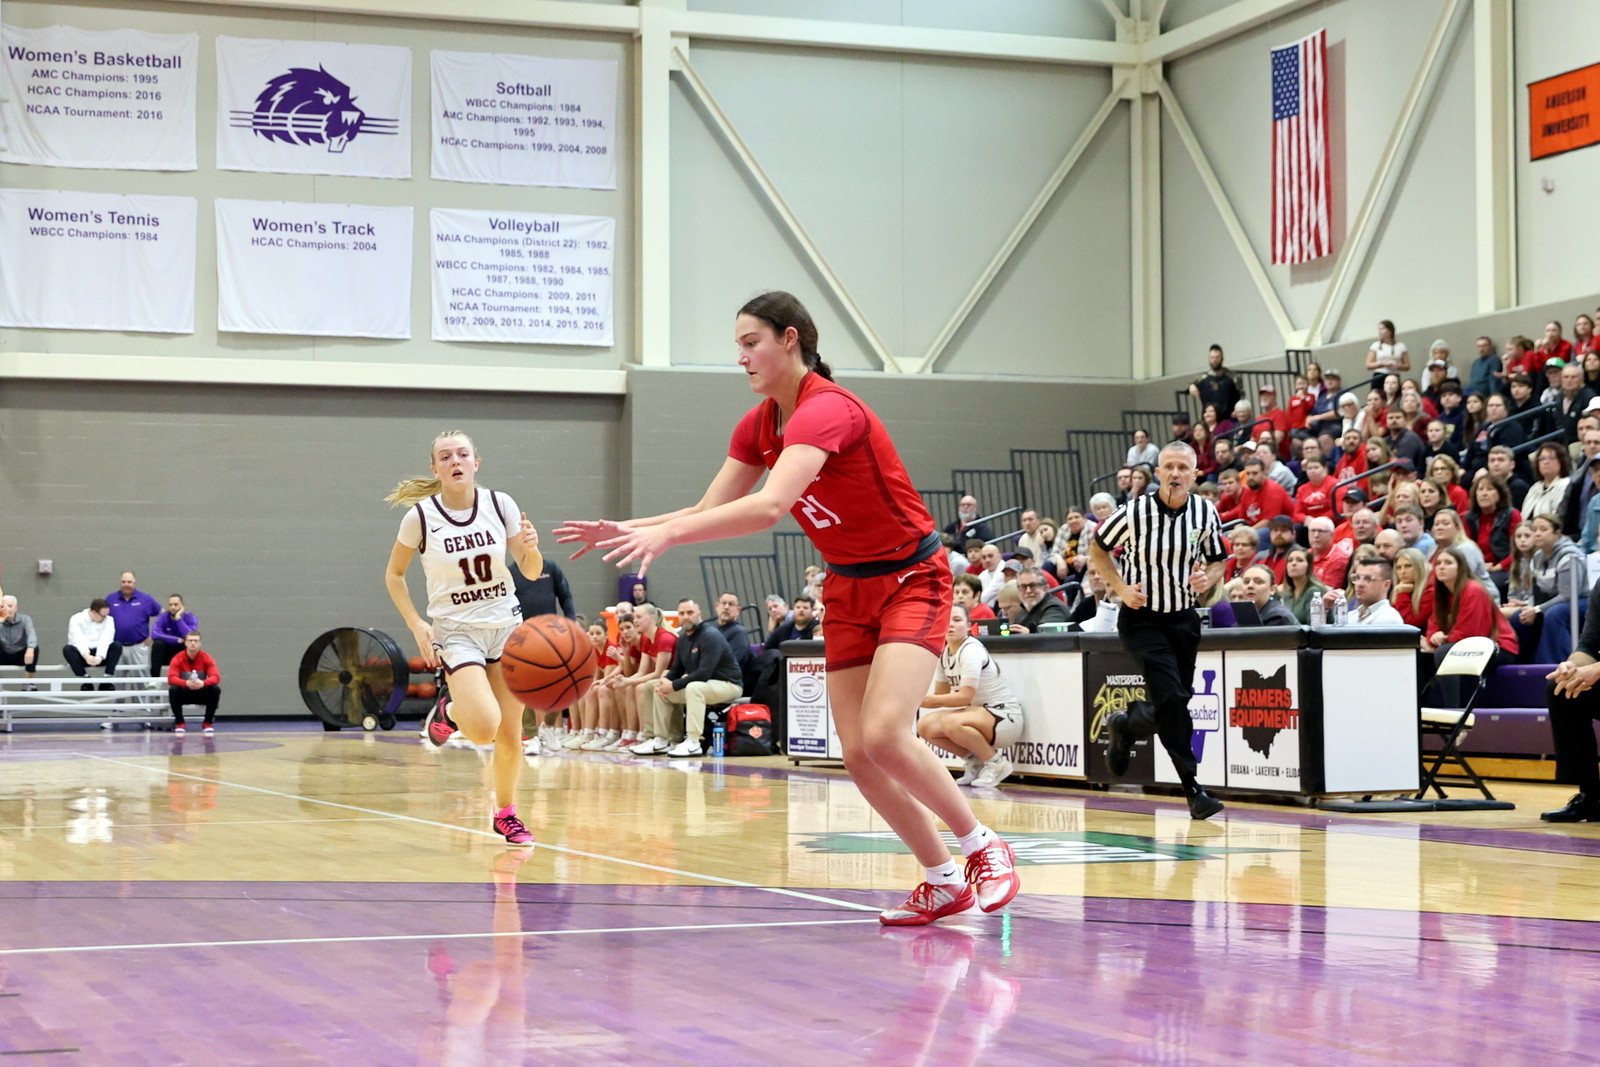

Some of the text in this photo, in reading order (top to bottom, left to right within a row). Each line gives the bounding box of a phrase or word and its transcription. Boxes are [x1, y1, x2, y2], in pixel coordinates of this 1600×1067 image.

[8, 46, 181, 69] Women’s Basketball
[31, 69, 158, 84] AMC Champions: 1995
[27, 85, 162, 101] HCAC Champions: 2016
[496, 82, 551, 96] Softball
[26, 104, 163, 120] NCAA Tournament: 2016
[465, 98, 581, 113] WBCC Champions: 1984
[443, 110, 605, 129] AMC Champions: 1992, 1993, 1994,
[513, 127, 535, 137] 1995
[441, 136, 607, 155] HCAC Champions: 1999, 2004, 2008
[28, 207, 160, 227] Women’s Tennis
[29, 227, 158, 241] WBCC Champions: 1984
[252, 218, 375, 236] Women’s Track
[489, 218, 559, 235] Volleyball
[251, 237, 377, 251] HCAC Champions: 2004
[437, 233, 610, 250] NAIA Champions (District 22): 1982,
[500, 249, 550, 259] 1985, 1988
[436, 260, 611, 277] WBCC Champions: 1982, 1984, 1985,
[486, 274, 564, 286] 1987, 1988, 1990
[452, 287, 596, 301] HCAC Champions: 2009, 2011
[449, 302, 599, 316] NCAA Tournament: 1994, 1996,
[444, 316, 604, 330] 1997, 2009, 2013, 2014, 2015, 2016
[797, 494, 842, 529] 21
[444, 530, 496, 553] GENOA
[459, 554, 492, 586] 10
[451, 582, 507, 605] COMETS
[1235, 687, 1292, 708] FARMERS
[1229, 707, 1299, 729] EQUIPMENT
[1000, 742, 1079, 768] AVERS.COM
[1230, 764, 1249, 775] URBANA
[1254, 766, 1280, 777] LAKEVIEW
